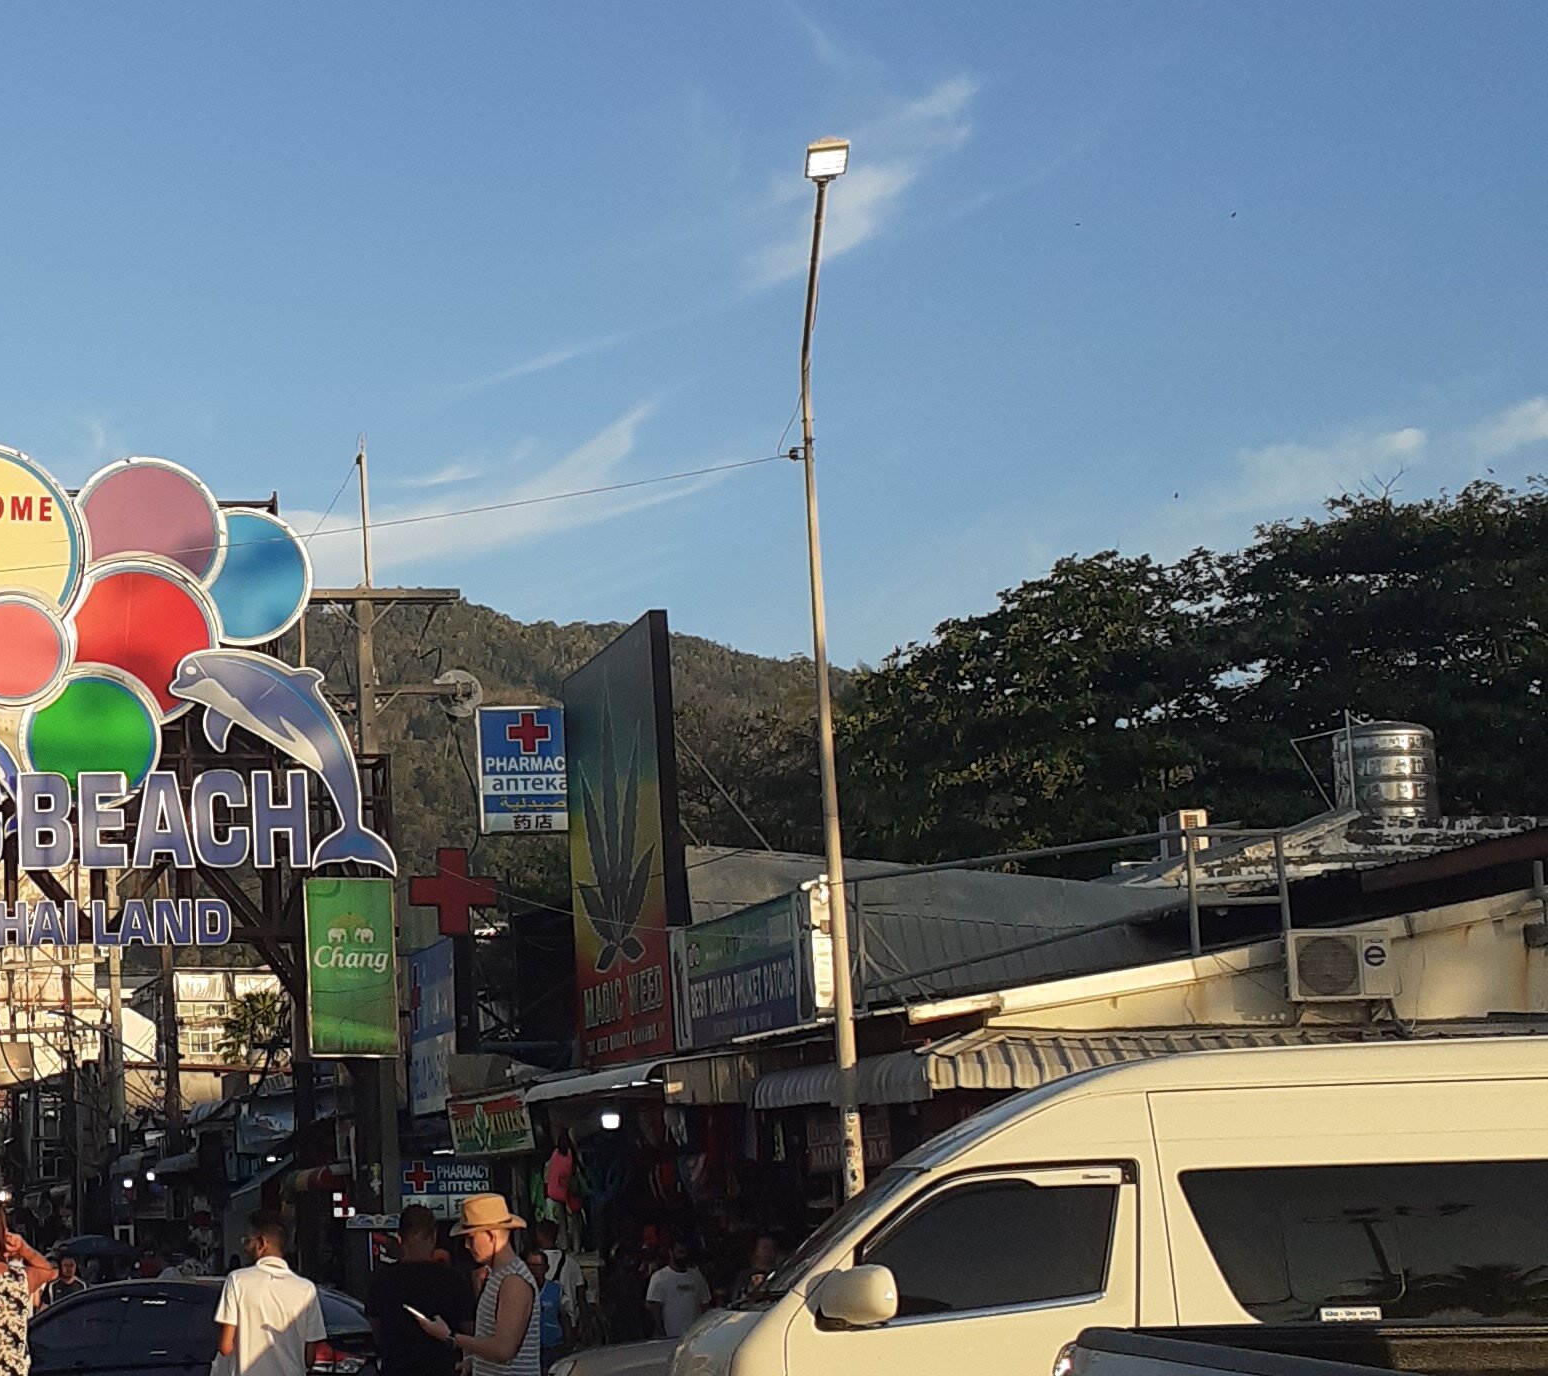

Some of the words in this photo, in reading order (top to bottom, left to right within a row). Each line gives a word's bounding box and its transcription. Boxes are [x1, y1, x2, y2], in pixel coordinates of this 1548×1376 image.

[485, 755, 566, 772] PHARMAC
[492, 776, 568, 791] аптека
[16, 768, 311, 873] BEACH
[513, 814, 552, 830] 药店
[313, 945, 390, 974] Chang
[583, 978, 623, 1031] MAGIC
[626, 963, 664, 1017] WEED
[437, 1164, 491, 1179] PHARMACY
[439, 1180, 490, 1192] аптека
